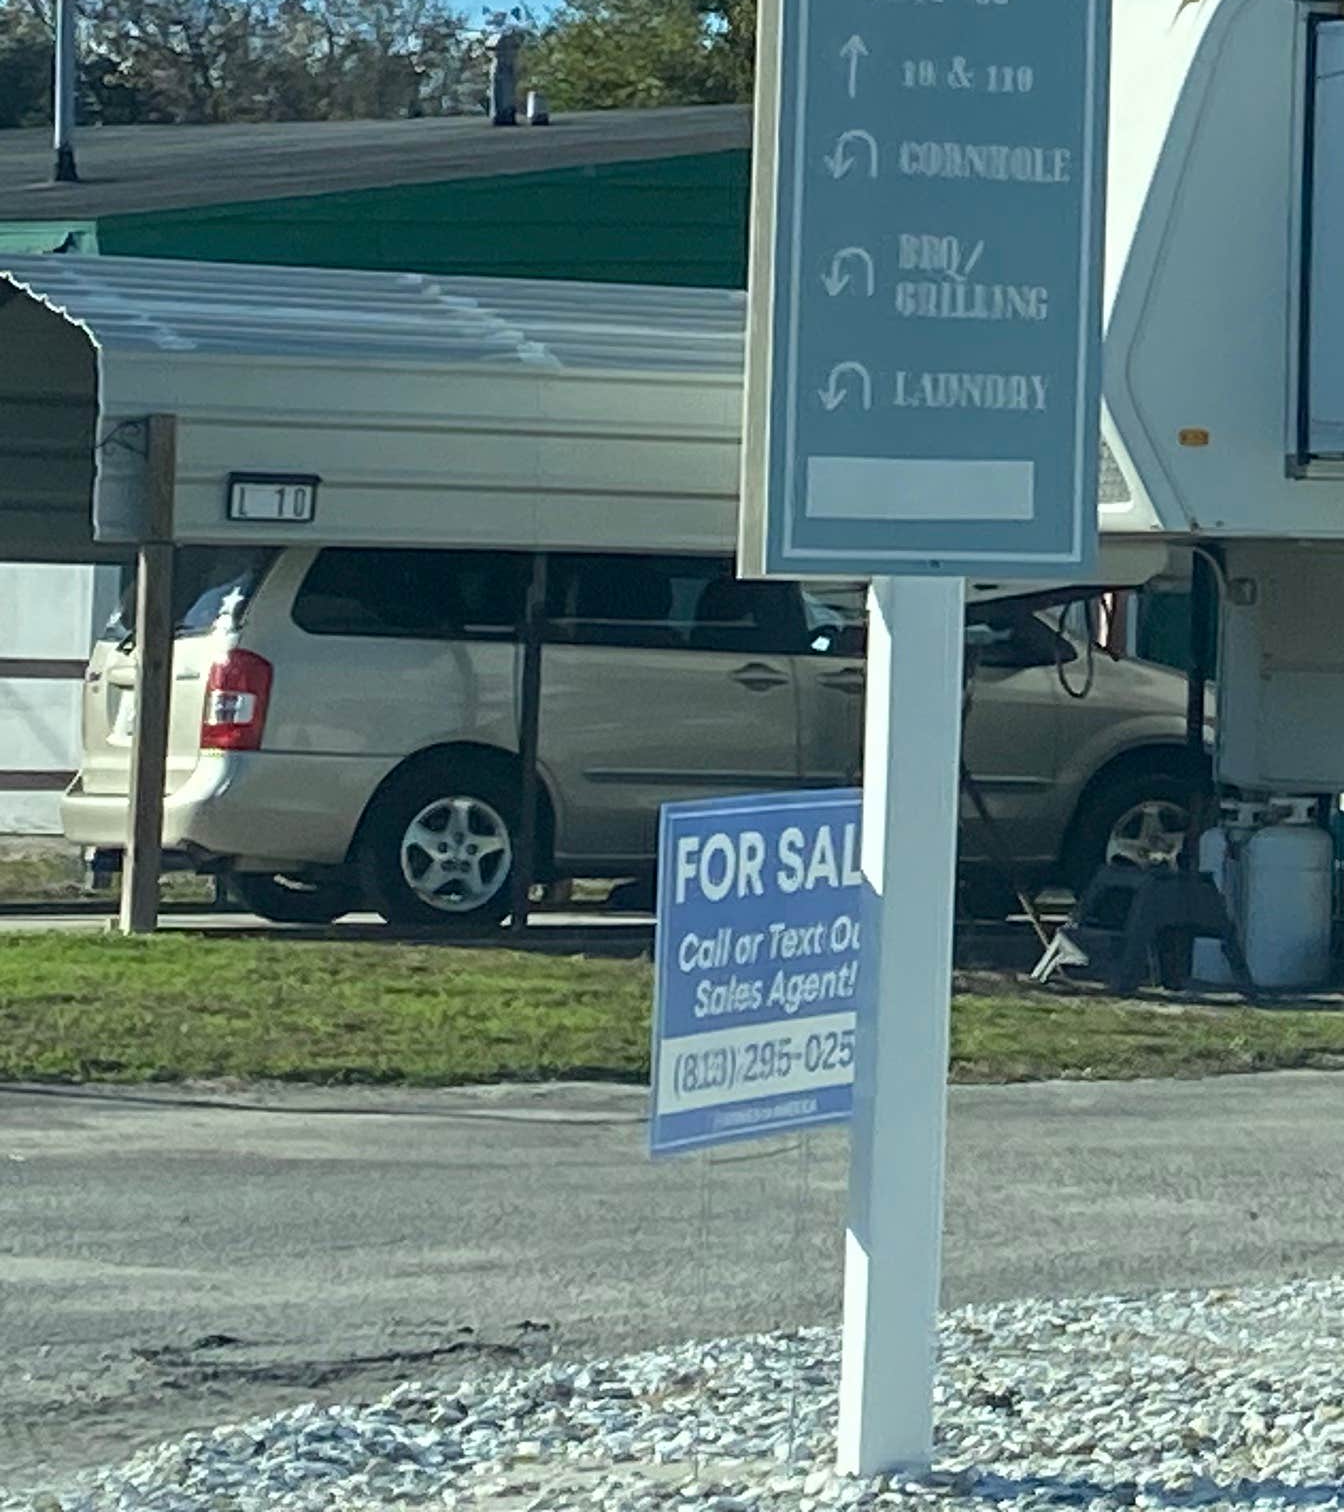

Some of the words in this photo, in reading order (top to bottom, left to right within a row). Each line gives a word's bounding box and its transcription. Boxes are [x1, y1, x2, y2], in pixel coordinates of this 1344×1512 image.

[900, 141, 1071, 182] CORNHOLE
[896, 282, 1049, 320] GRILLING
[893, 370, 1049, 410] LAUNDRY
[275, 487, 307, 518] 10
[675, 831, 766, 904] FOR
[776, 823, 863, 894] SAL
[678, 928, 731, 973] Call
[734, 934, 764, 965] or
[767, 920, 824, 959] Text
[694, 974, 763, 1018] Sales
[766, 960, 859, 1014] Agent!
[742, 1029, 855, 1082] 295-025
